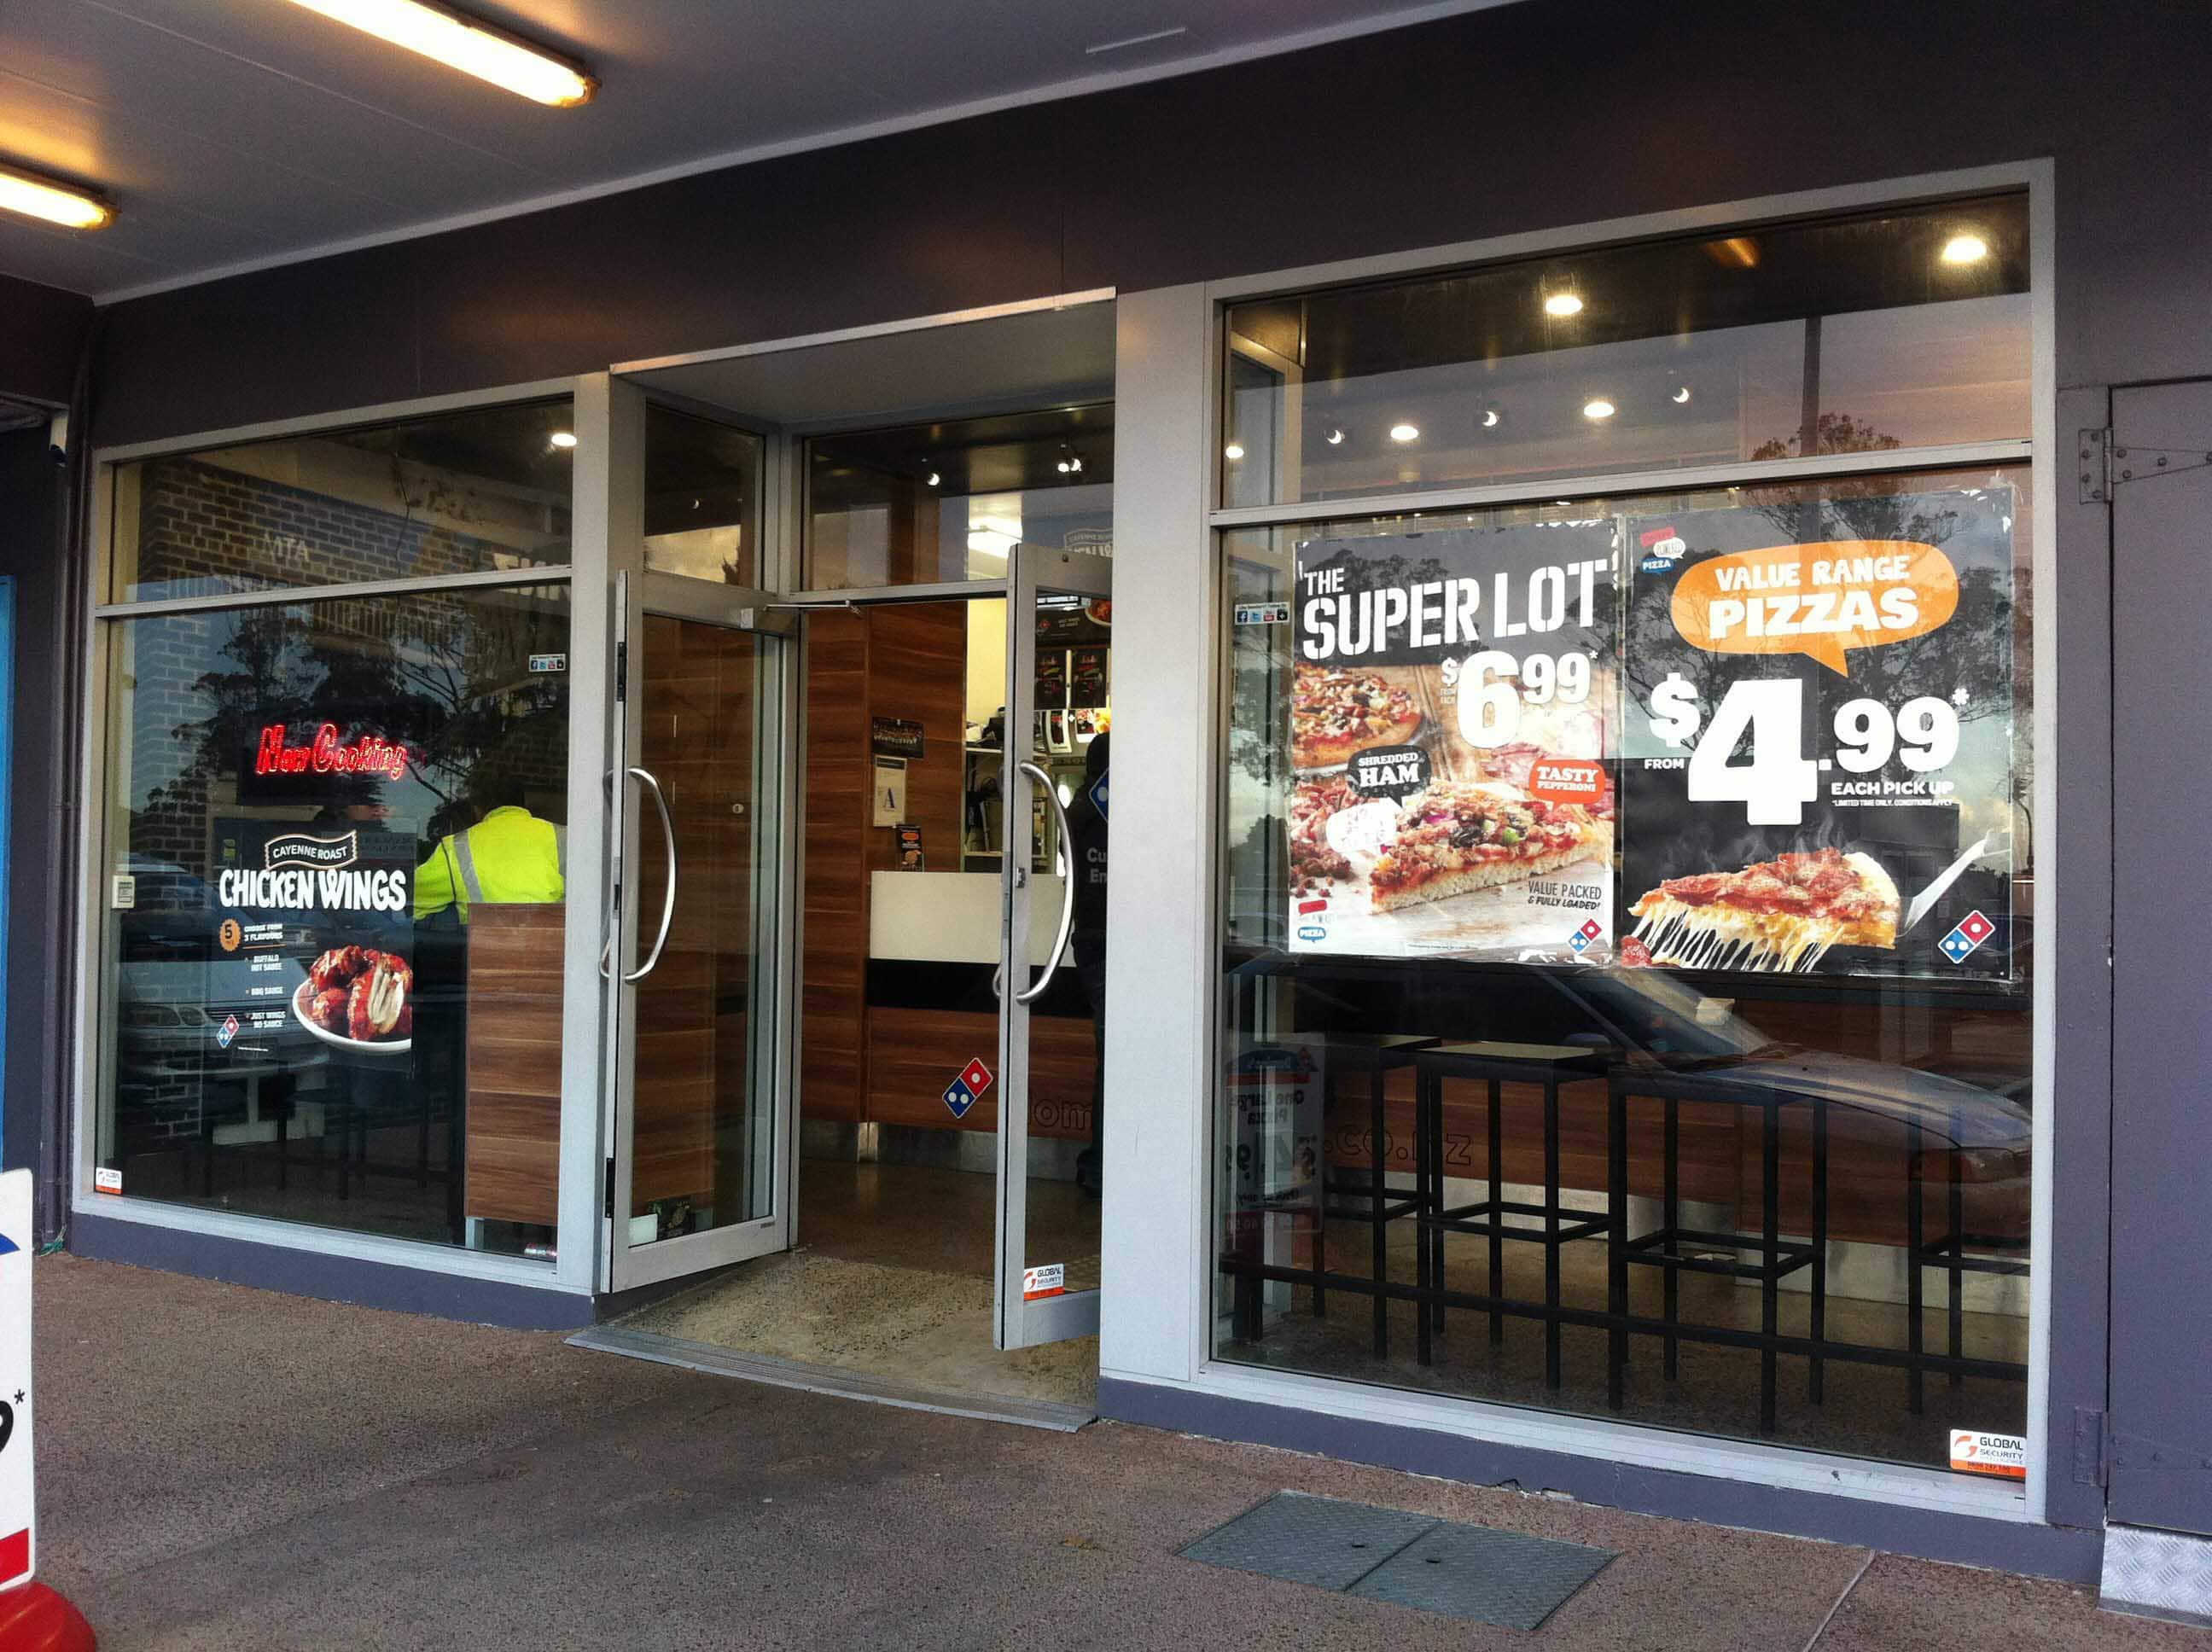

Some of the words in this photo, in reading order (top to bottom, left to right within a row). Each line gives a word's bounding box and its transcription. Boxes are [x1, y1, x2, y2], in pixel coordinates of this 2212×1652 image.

[1303, 567, 1345, 596] THE
[1714, 562, 1802, 592] VALUE
[1812, 556, 1911, 586] RANGE
[1302, 577, 1481, 660] SUPER
[1493, 559, 1609, 638] LOT
[1708, 586, 1920, 640] PIZZAS
[256, 724, 311, 775] Now
[312, 723, 408, 780] Cooking
[1358, 752, 1418, 767] SHREDDED
[1644, 758, 1685, 770] FROM
[1359, 763, 1420, 787] HAM
[1537, 765, 1598, 782] TASTY
[1831, 782, 1880, 795] EACH
[1883, 781, 1925, 795] PICK
[1929, 781, 1955, 794] UP
[884, 787, 896, 809] A
[272, 844, 317, 858] CAYENNE
[317, 846, 347, 860] ROAST
[218, 869, 316, 910] CHICKEN
[317, 869, 407, 911] WINGS
[1528, 881, 1558, 895] VALUE
[1562, 884, 1602, 899] PACKED
[1536, 897, 1561, 906] FULLY
[224, 923, 233, 939] 5
[1038, 1267, 1062, 1277] GLOBAL
[1980, 1436, 2023, 1451] GLOBAL
[1979, 1449, 2023, 1460] SECURITY
